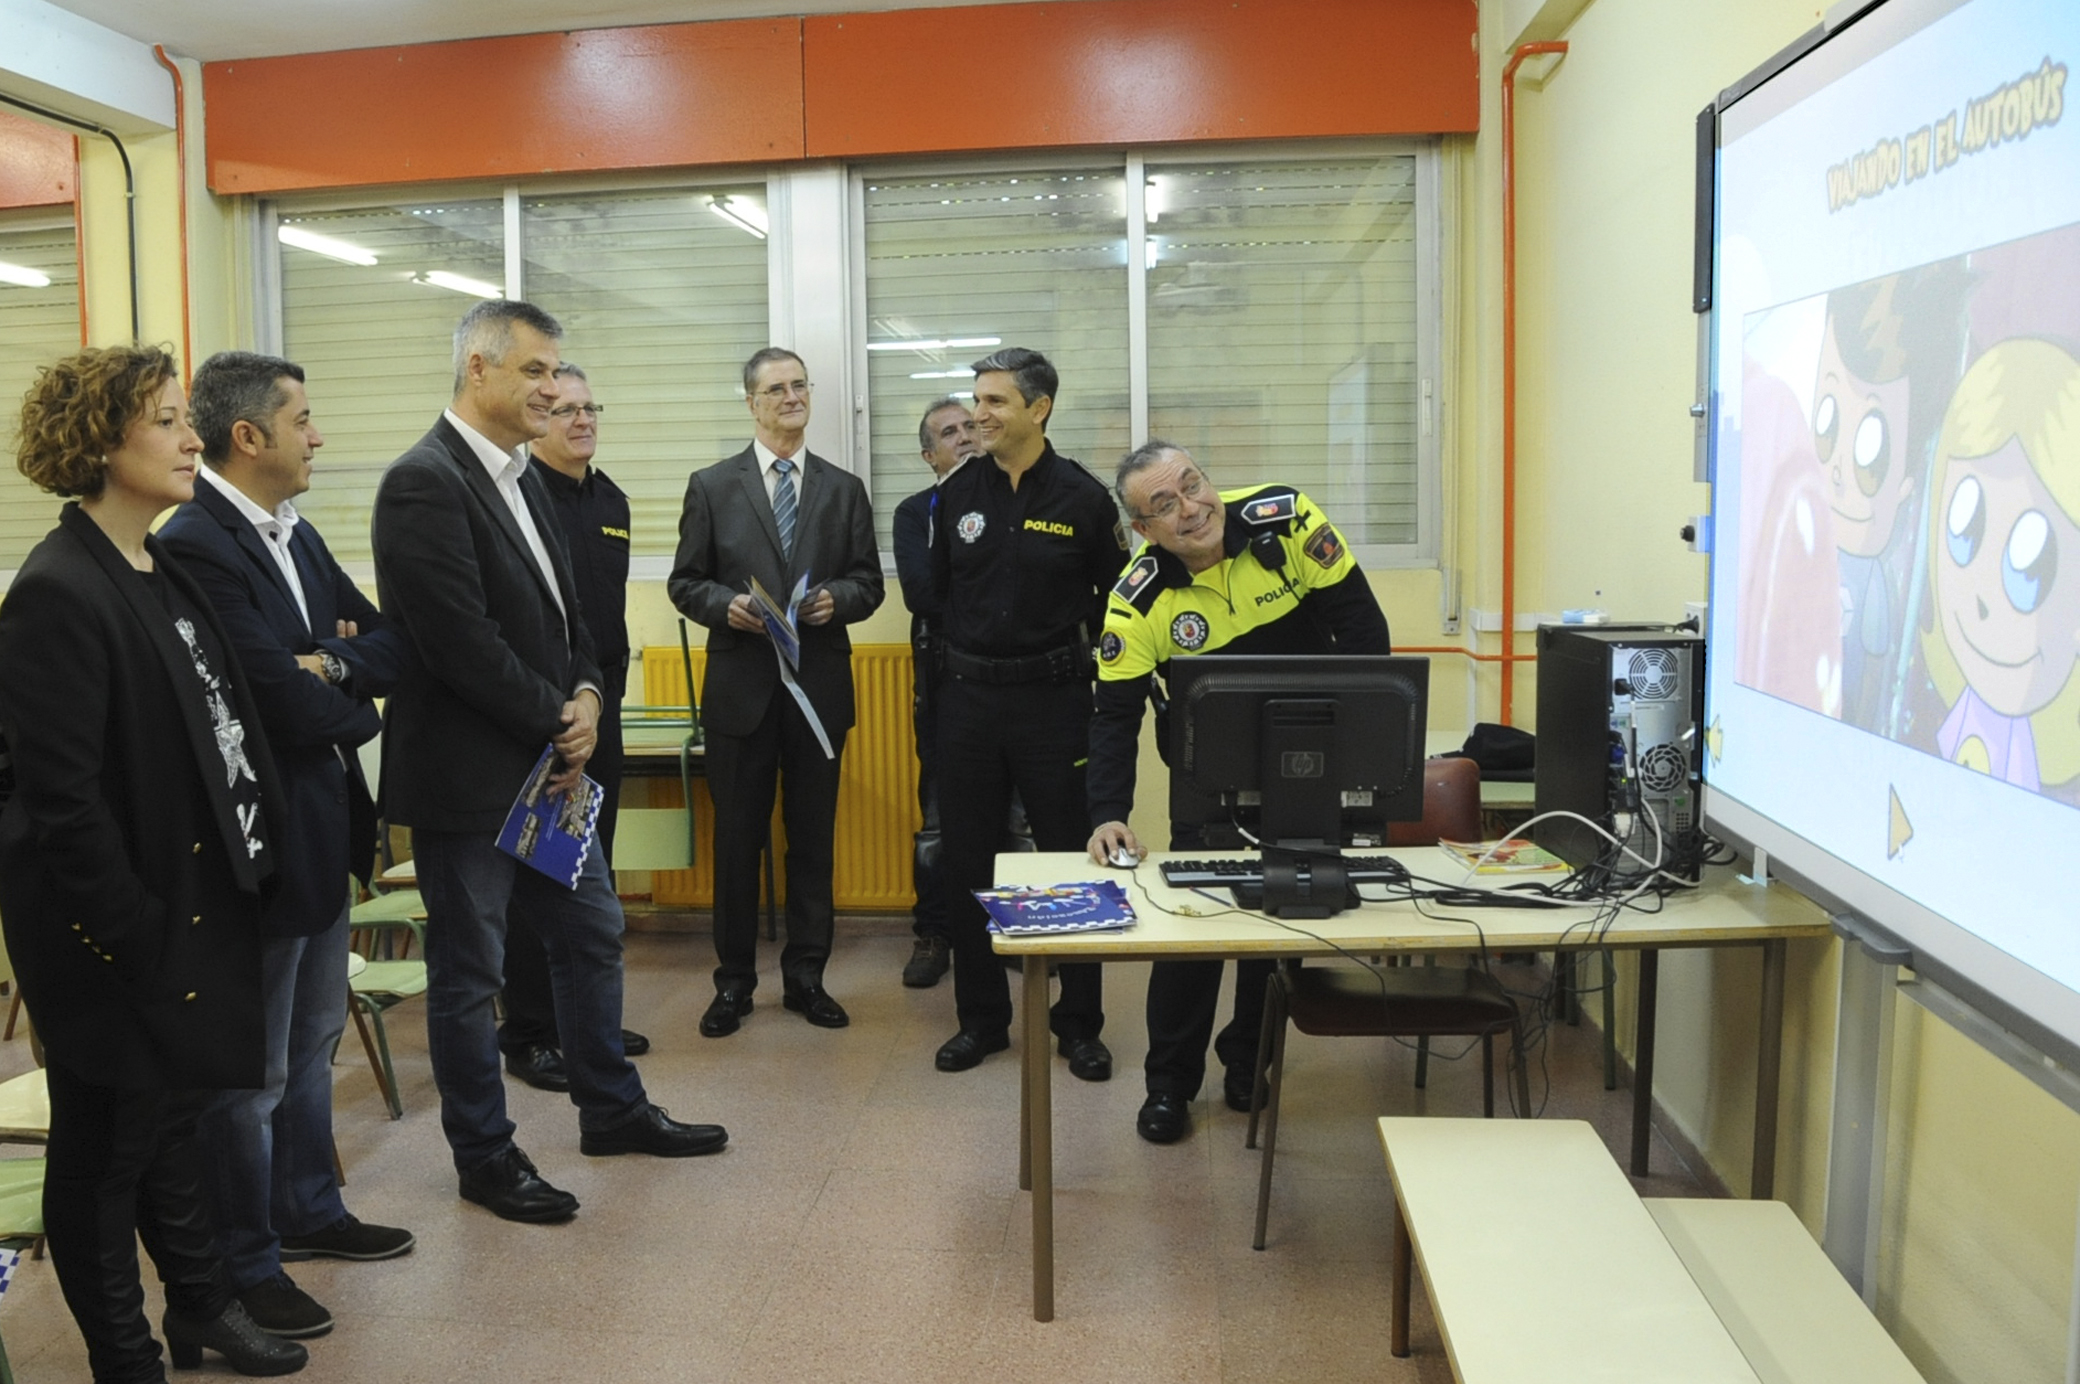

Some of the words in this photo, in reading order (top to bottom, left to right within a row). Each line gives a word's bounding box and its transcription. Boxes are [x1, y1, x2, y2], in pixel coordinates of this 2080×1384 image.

[1905, 125, 1931, 185] EN
[1934, 109, 1959, 174] EL
[1961, 55, 2068, 156] AUTOBÚS
[1024, 519, 1073, 537] POLICIA
[1254, 577, 1300, 607] POLICA
